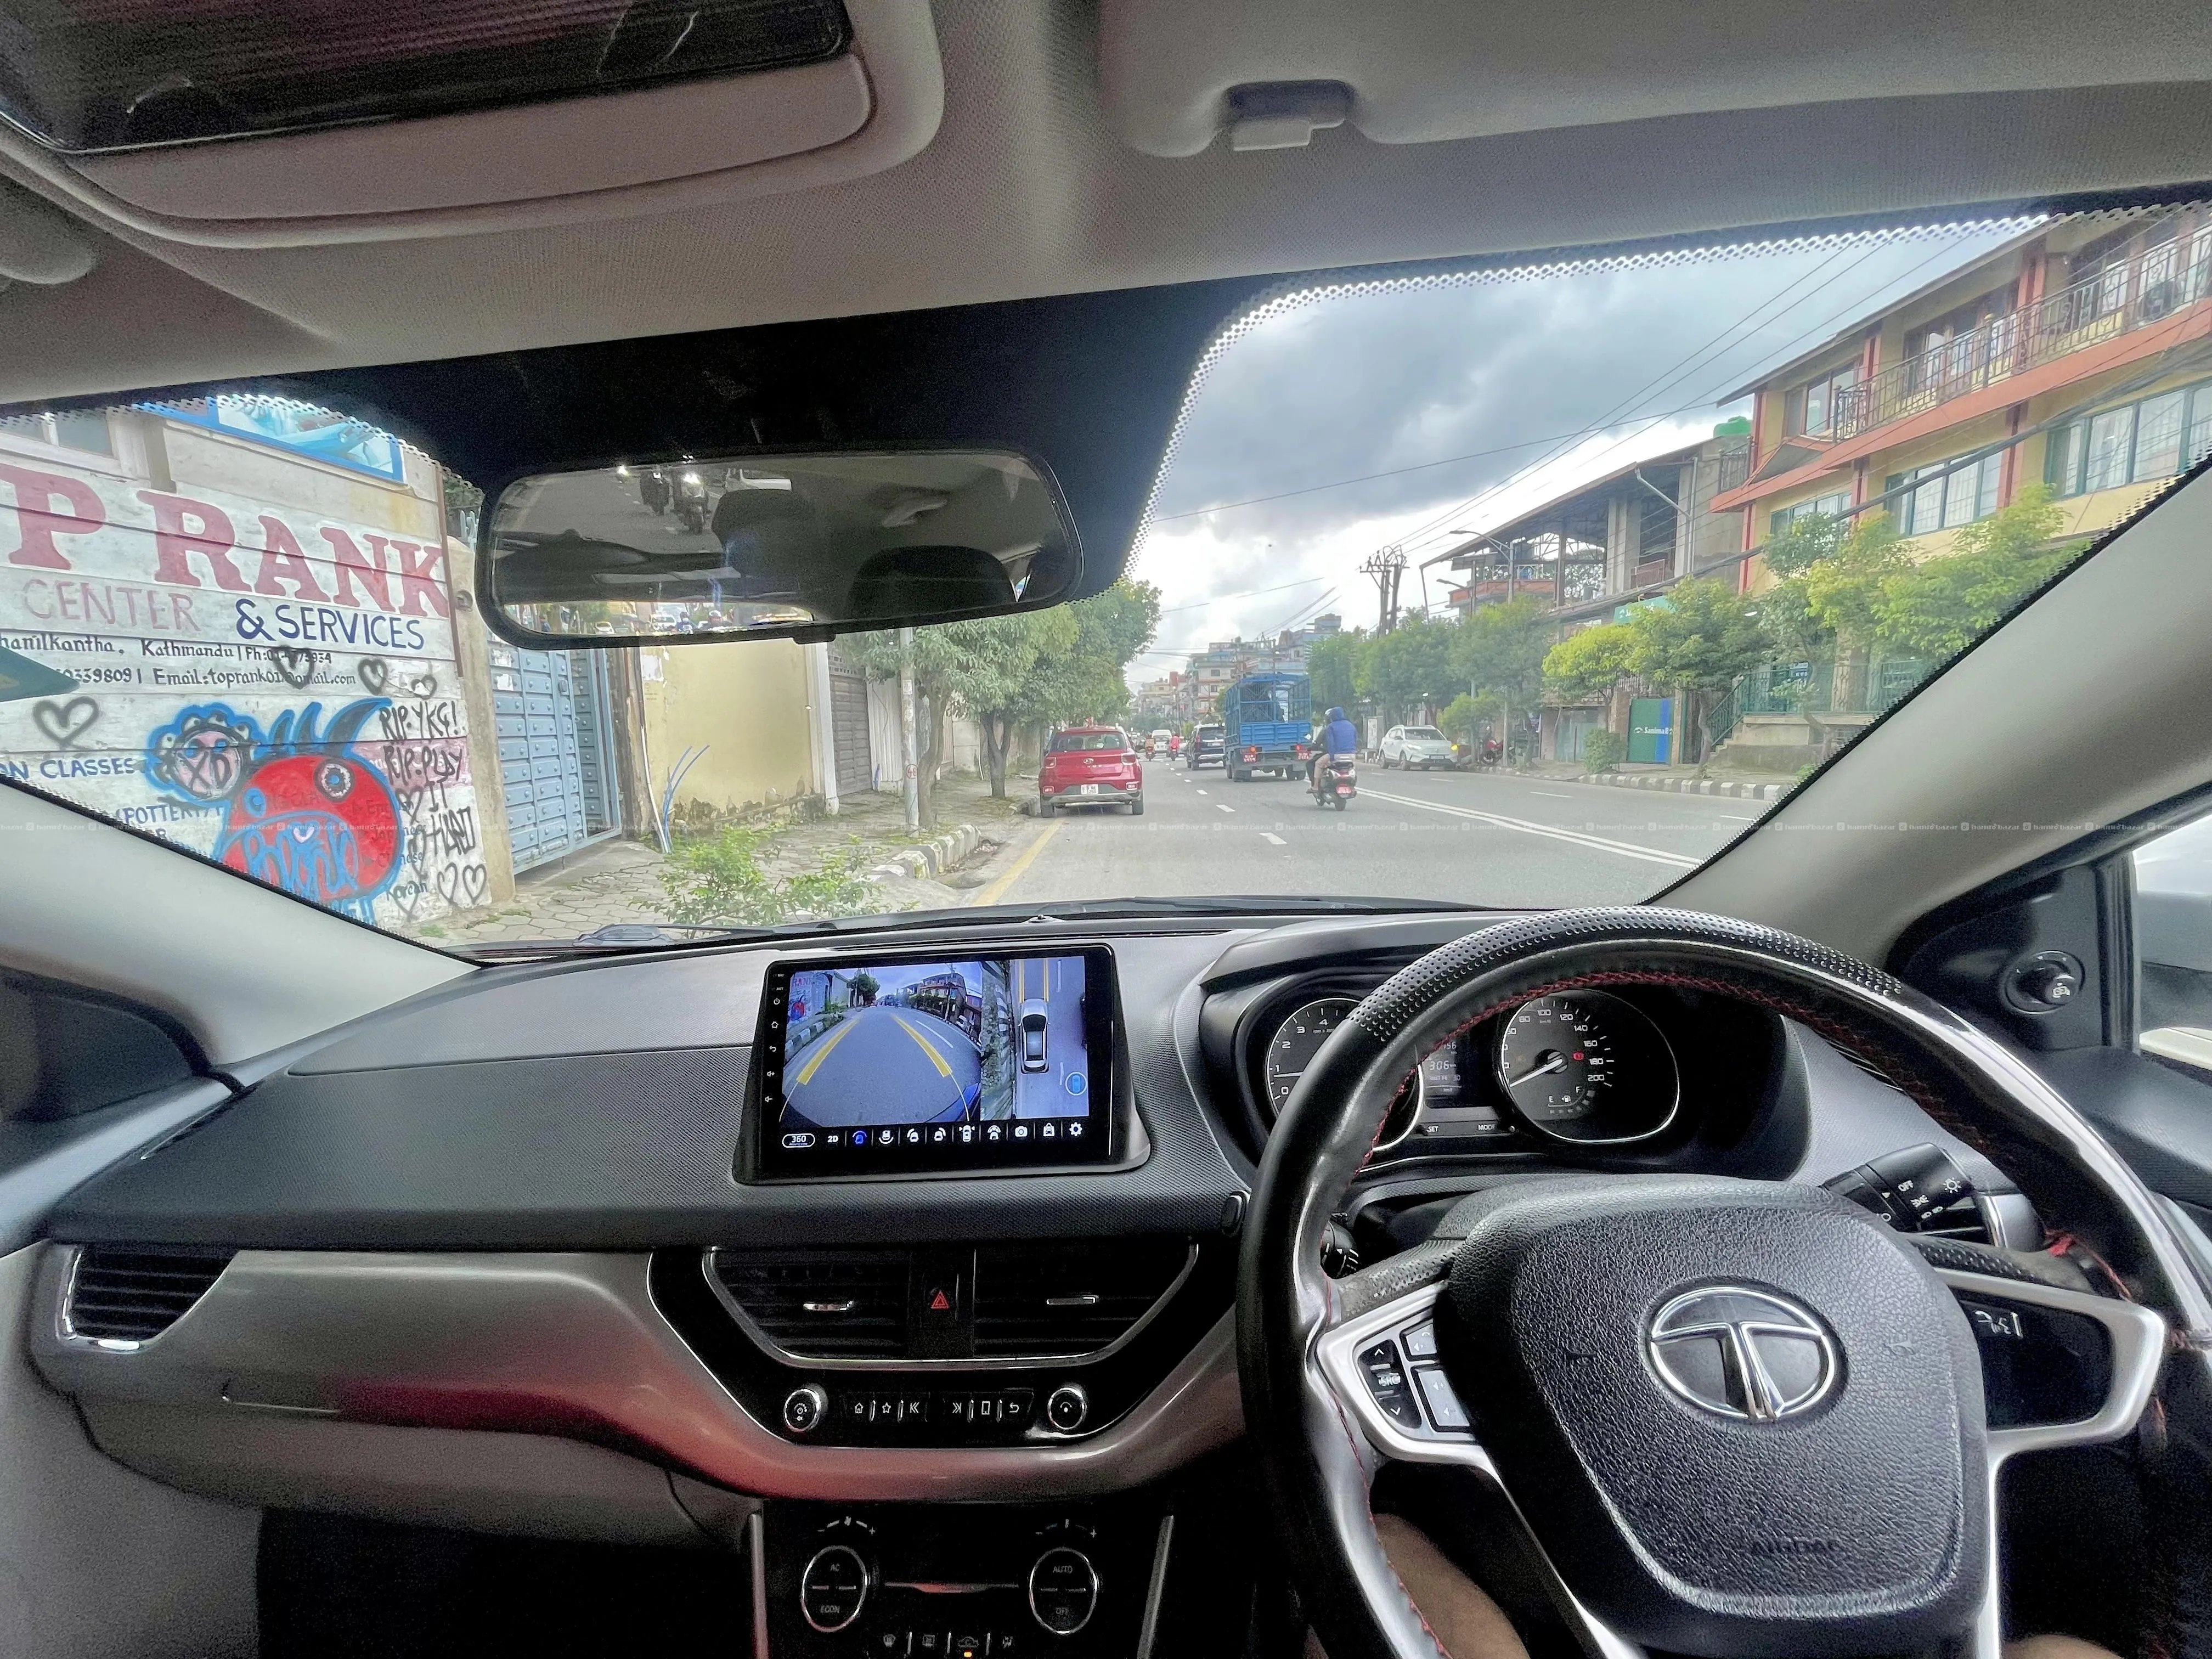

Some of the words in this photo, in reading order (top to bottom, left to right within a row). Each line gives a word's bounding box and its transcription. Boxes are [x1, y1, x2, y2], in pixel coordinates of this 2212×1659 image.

[136, 489, 451, 618] RANK
[22, 579, 202, 631] CENTER
[236, 598, 276, 641] &
[276, 603, 425, 651] SERVICES
[141, 639, 233, 657] Kathmandu
[40, 758, 135, 780] CLASSES
[1282, 1041, 1291, 1049] 2
[1275, 1064, 1280, 1072] 1
[1429, 1060, 1449, 1070] 306
[1280, 1086, 1289, 1094] 0
[1898, 1180, 1914, 1192] OFF
[1053, 1565, 1073, 1574] AUTO
